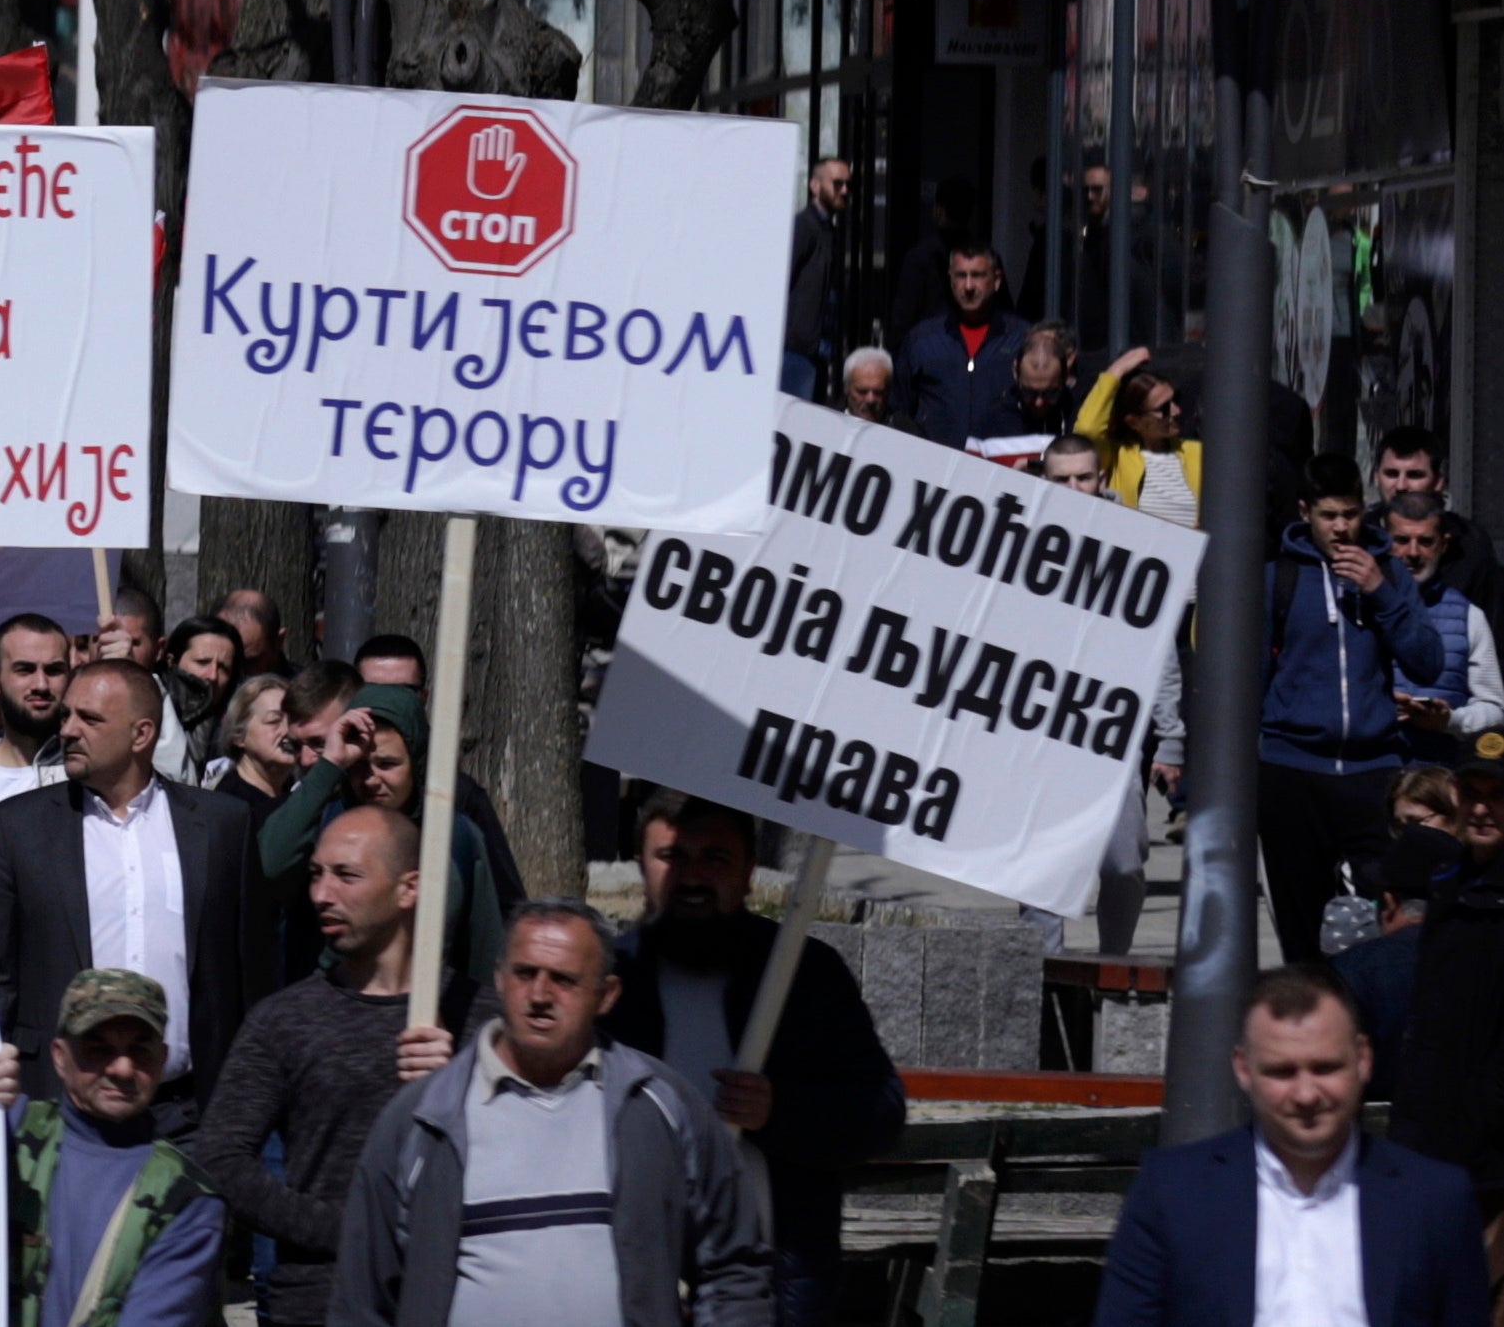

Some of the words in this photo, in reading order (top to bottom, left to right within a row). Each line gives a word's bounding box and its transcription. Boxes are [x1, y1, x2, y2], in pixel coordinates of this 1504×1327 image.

[319, 399, 619, 512] терору
[644, 536, 841, 662] своја
[846, 604, 1141, 760] људска
[737, 708, 961, 842] права
